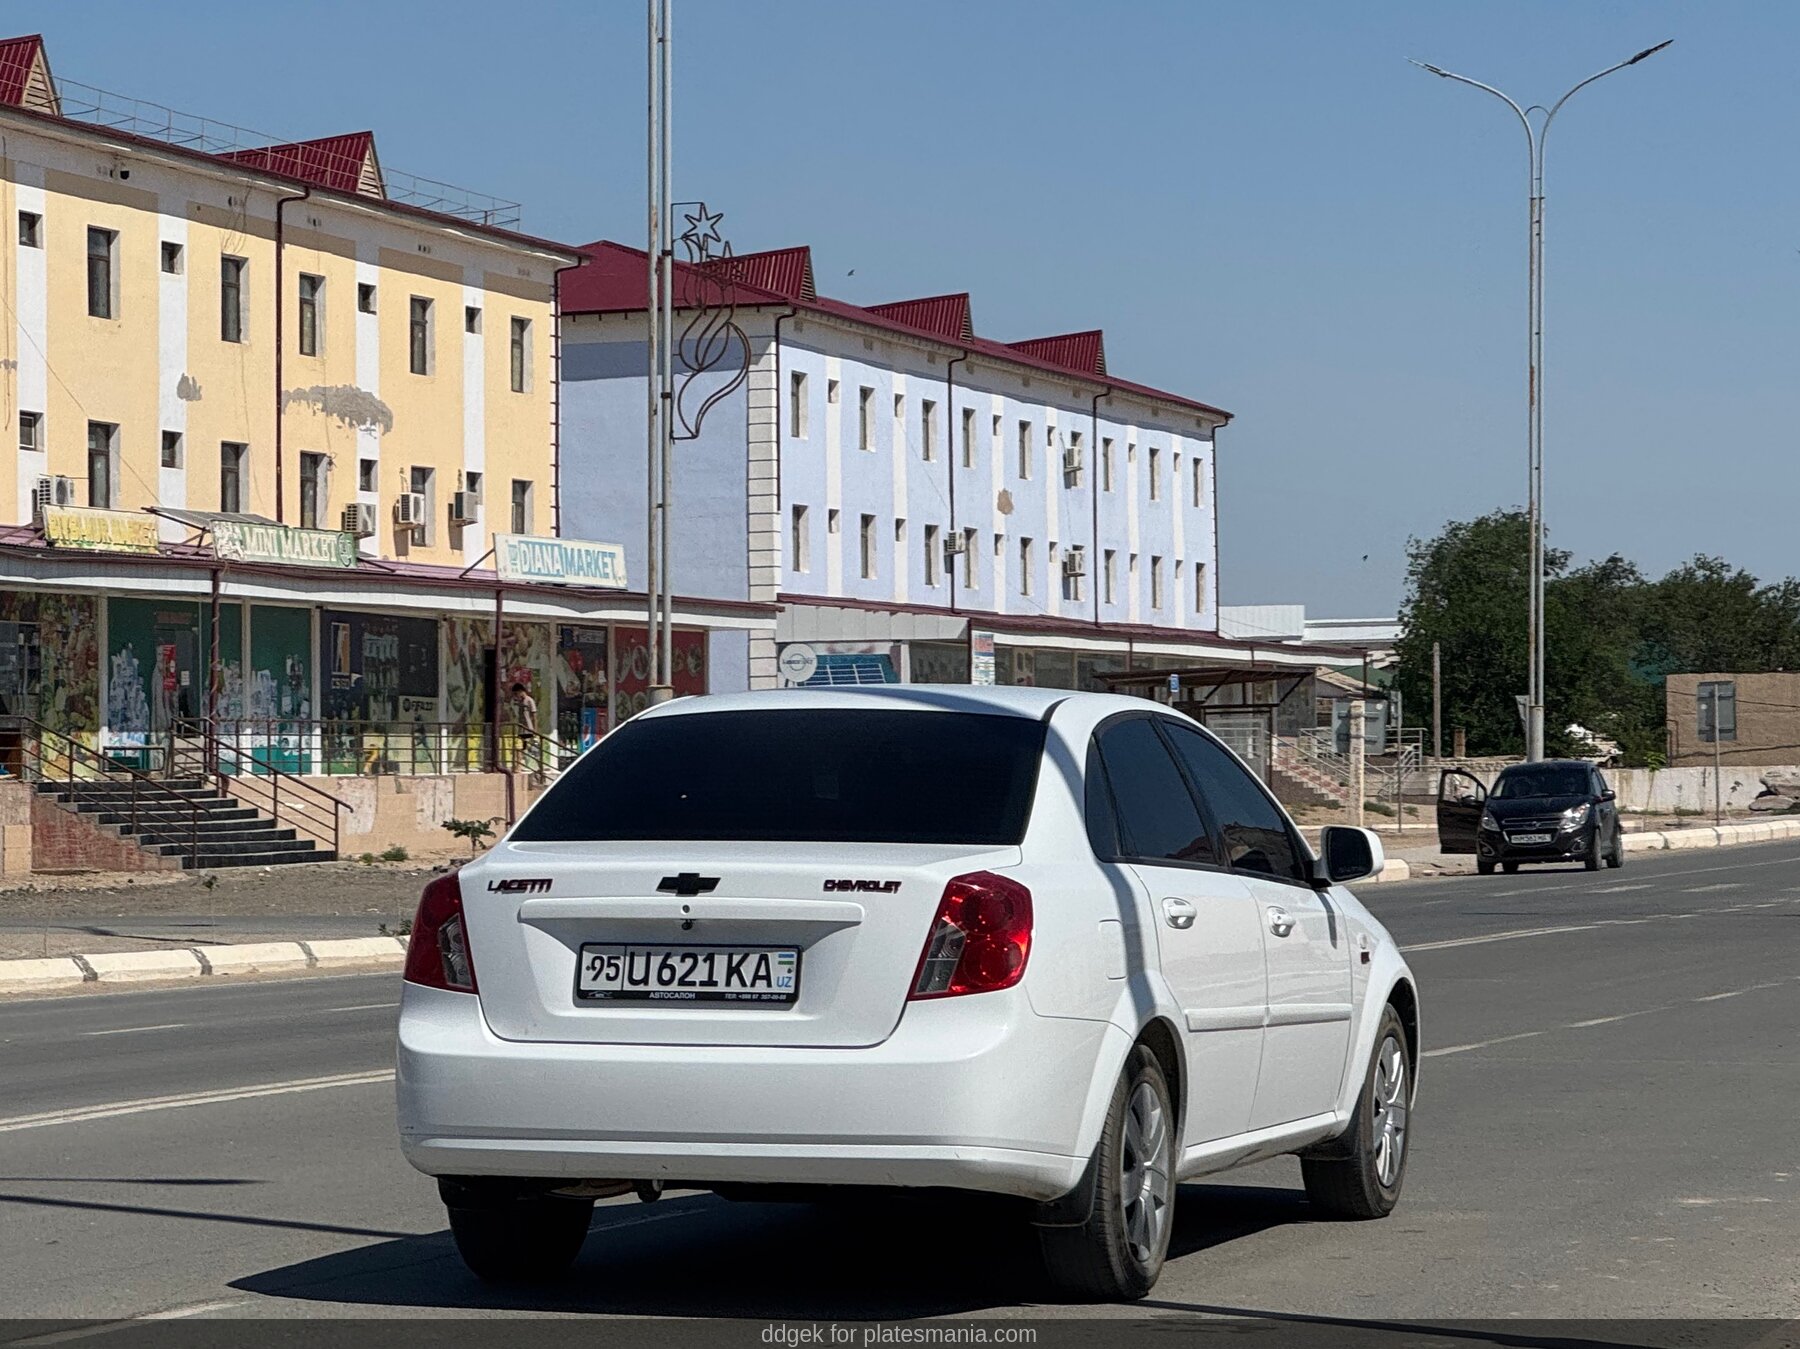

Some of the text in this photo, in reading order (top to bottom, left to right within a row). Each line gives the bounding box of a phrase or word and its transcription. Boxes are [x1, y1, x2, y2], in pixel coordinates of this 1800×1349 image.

[243, 526, 280, 557] MINI
[280, 529, 338, 562] MARKET
[520, 542, 617, 580] DIANA MARKET
[823, 879, 902, 894] CHEVROLET
[589, 955, 621, 982] 95
[776, 976, 792, 988] UZ
